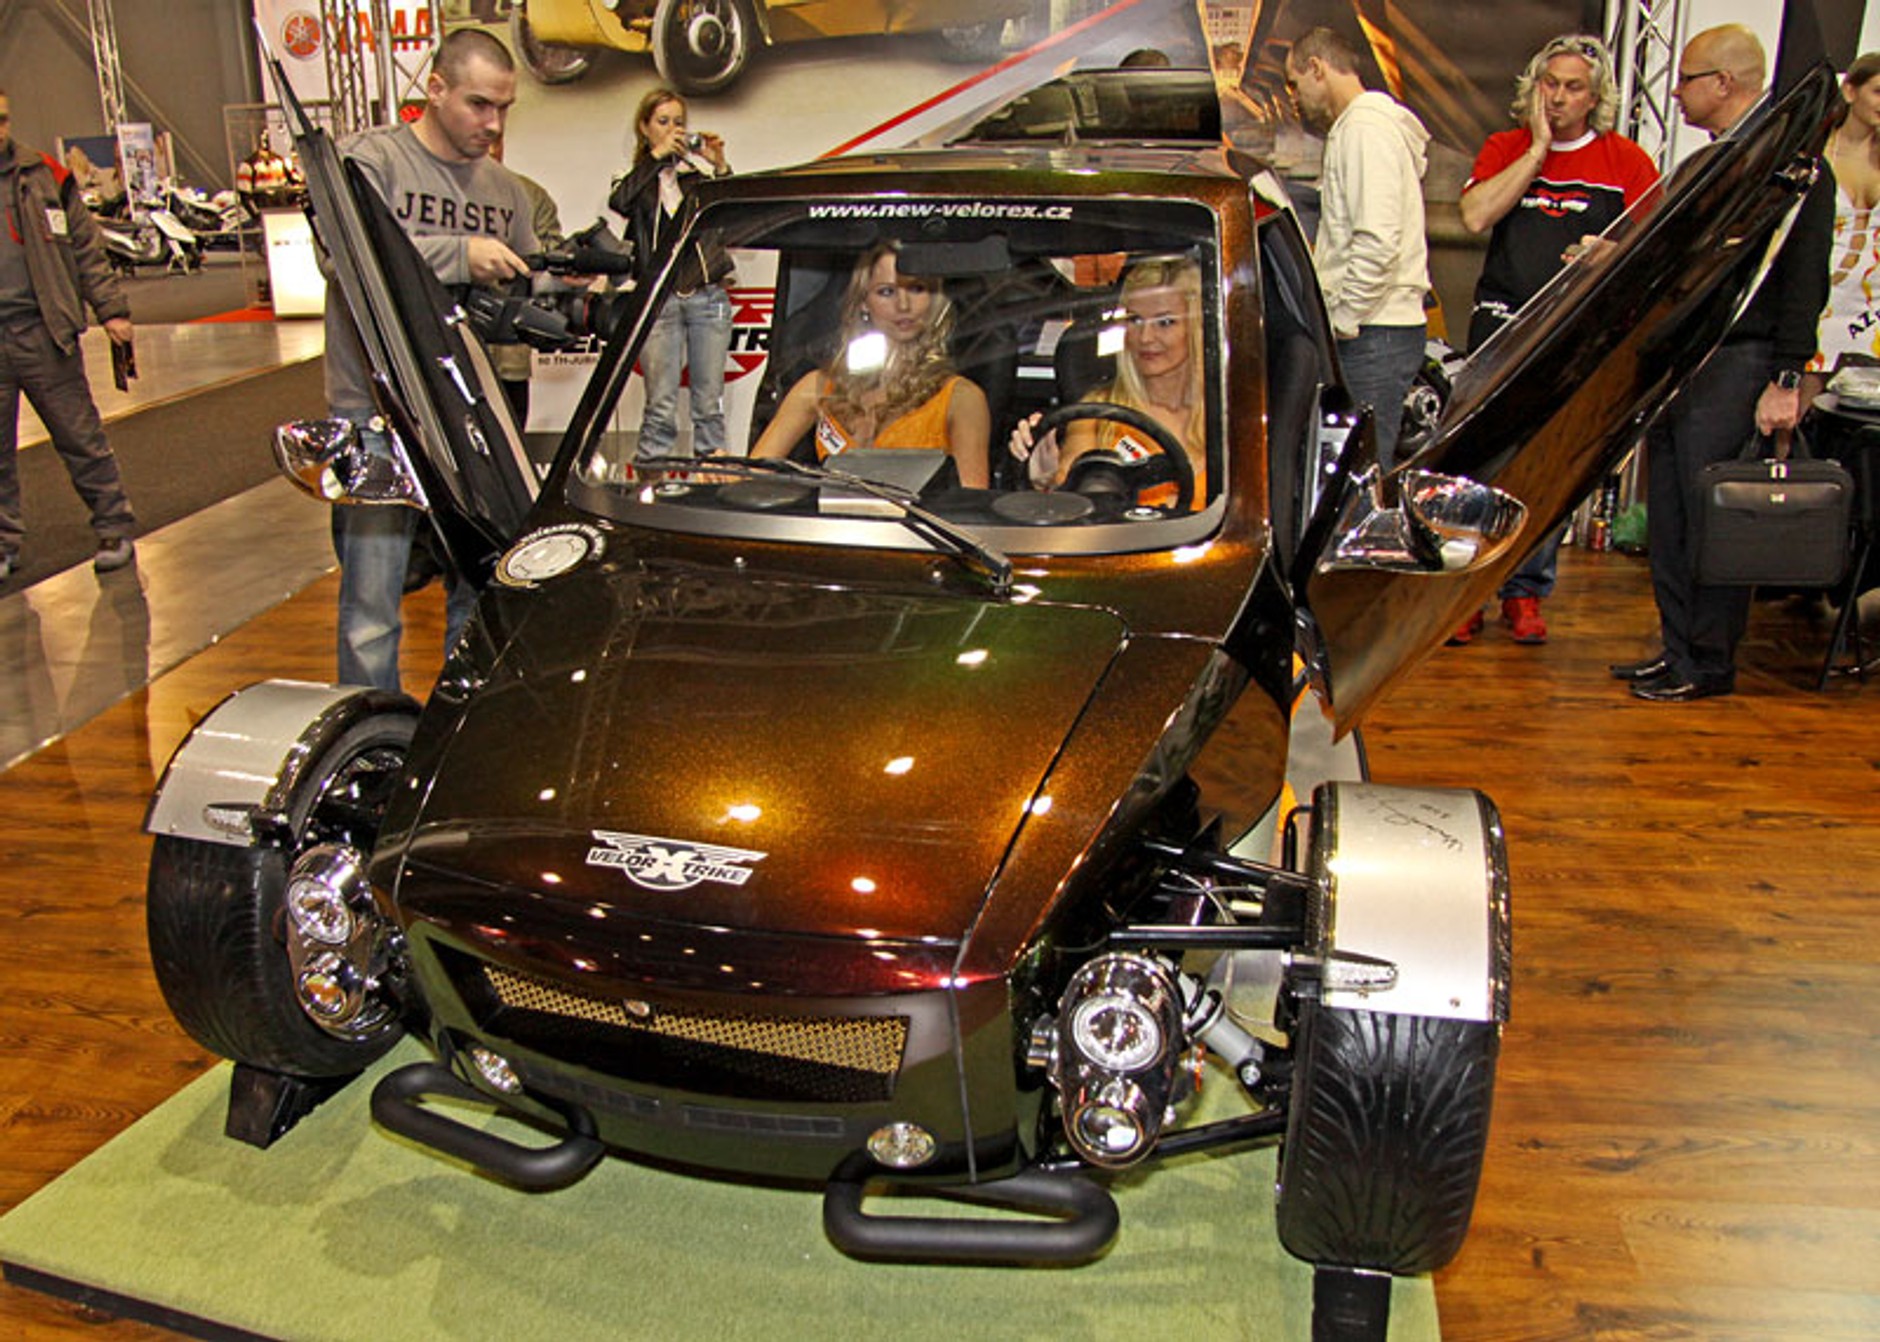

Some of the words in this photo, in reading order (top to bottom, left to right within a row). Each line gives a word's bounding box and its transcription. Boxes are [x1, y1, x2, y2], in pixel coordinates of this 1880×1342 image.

[397, 191, 514, 237] JERSEY
[809, 202, 1072, 220] www.new-velorex.cz
[591, 850, 657, 868] VELOR
[682, 863, 747, 881] TRIKE
